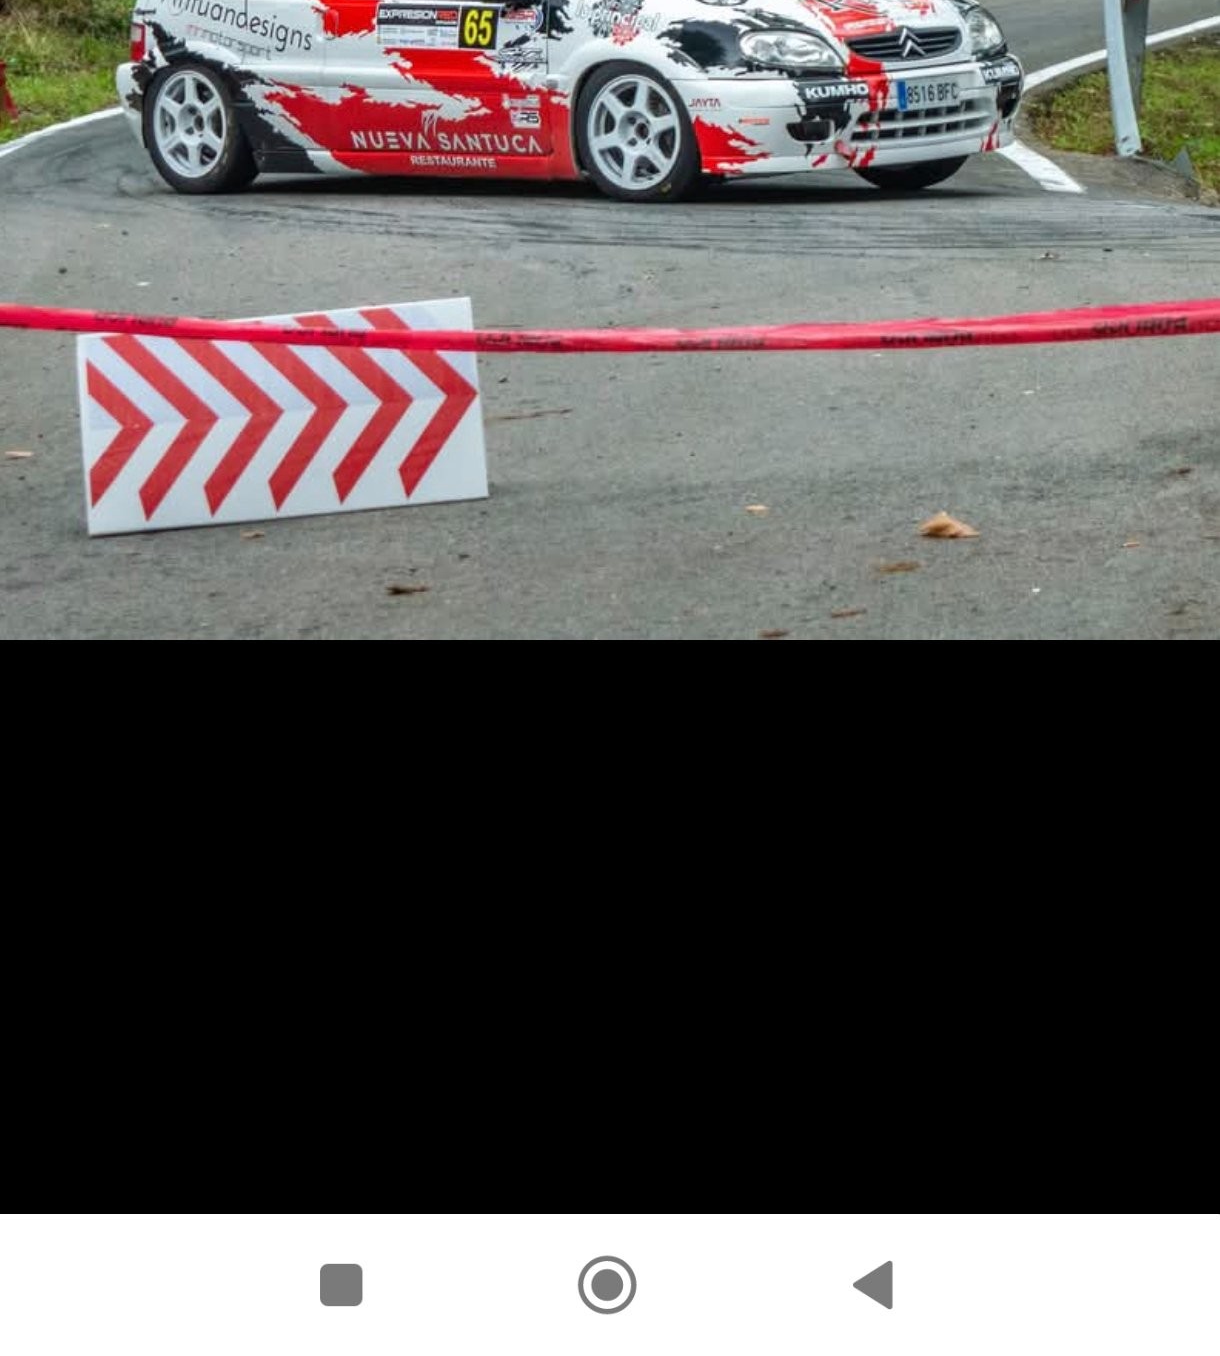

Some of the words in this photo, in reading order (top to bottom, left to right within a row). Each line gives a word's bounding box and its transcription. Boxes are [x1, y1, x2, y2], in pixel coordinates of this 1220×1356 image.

[463, 9, 493, 45] 65
[805, 83, 870, 99] KUMHO
[906, 84, 935, 104] 8516
[937, 82, 959, 100] BFC
[688, 98, 721, 108] JAYTA
[350, 130, 432, 150] NUEVA
[437, 132, 543, 155] SANTUCA
[410, 155, 498, 169] RESTAURANTE
